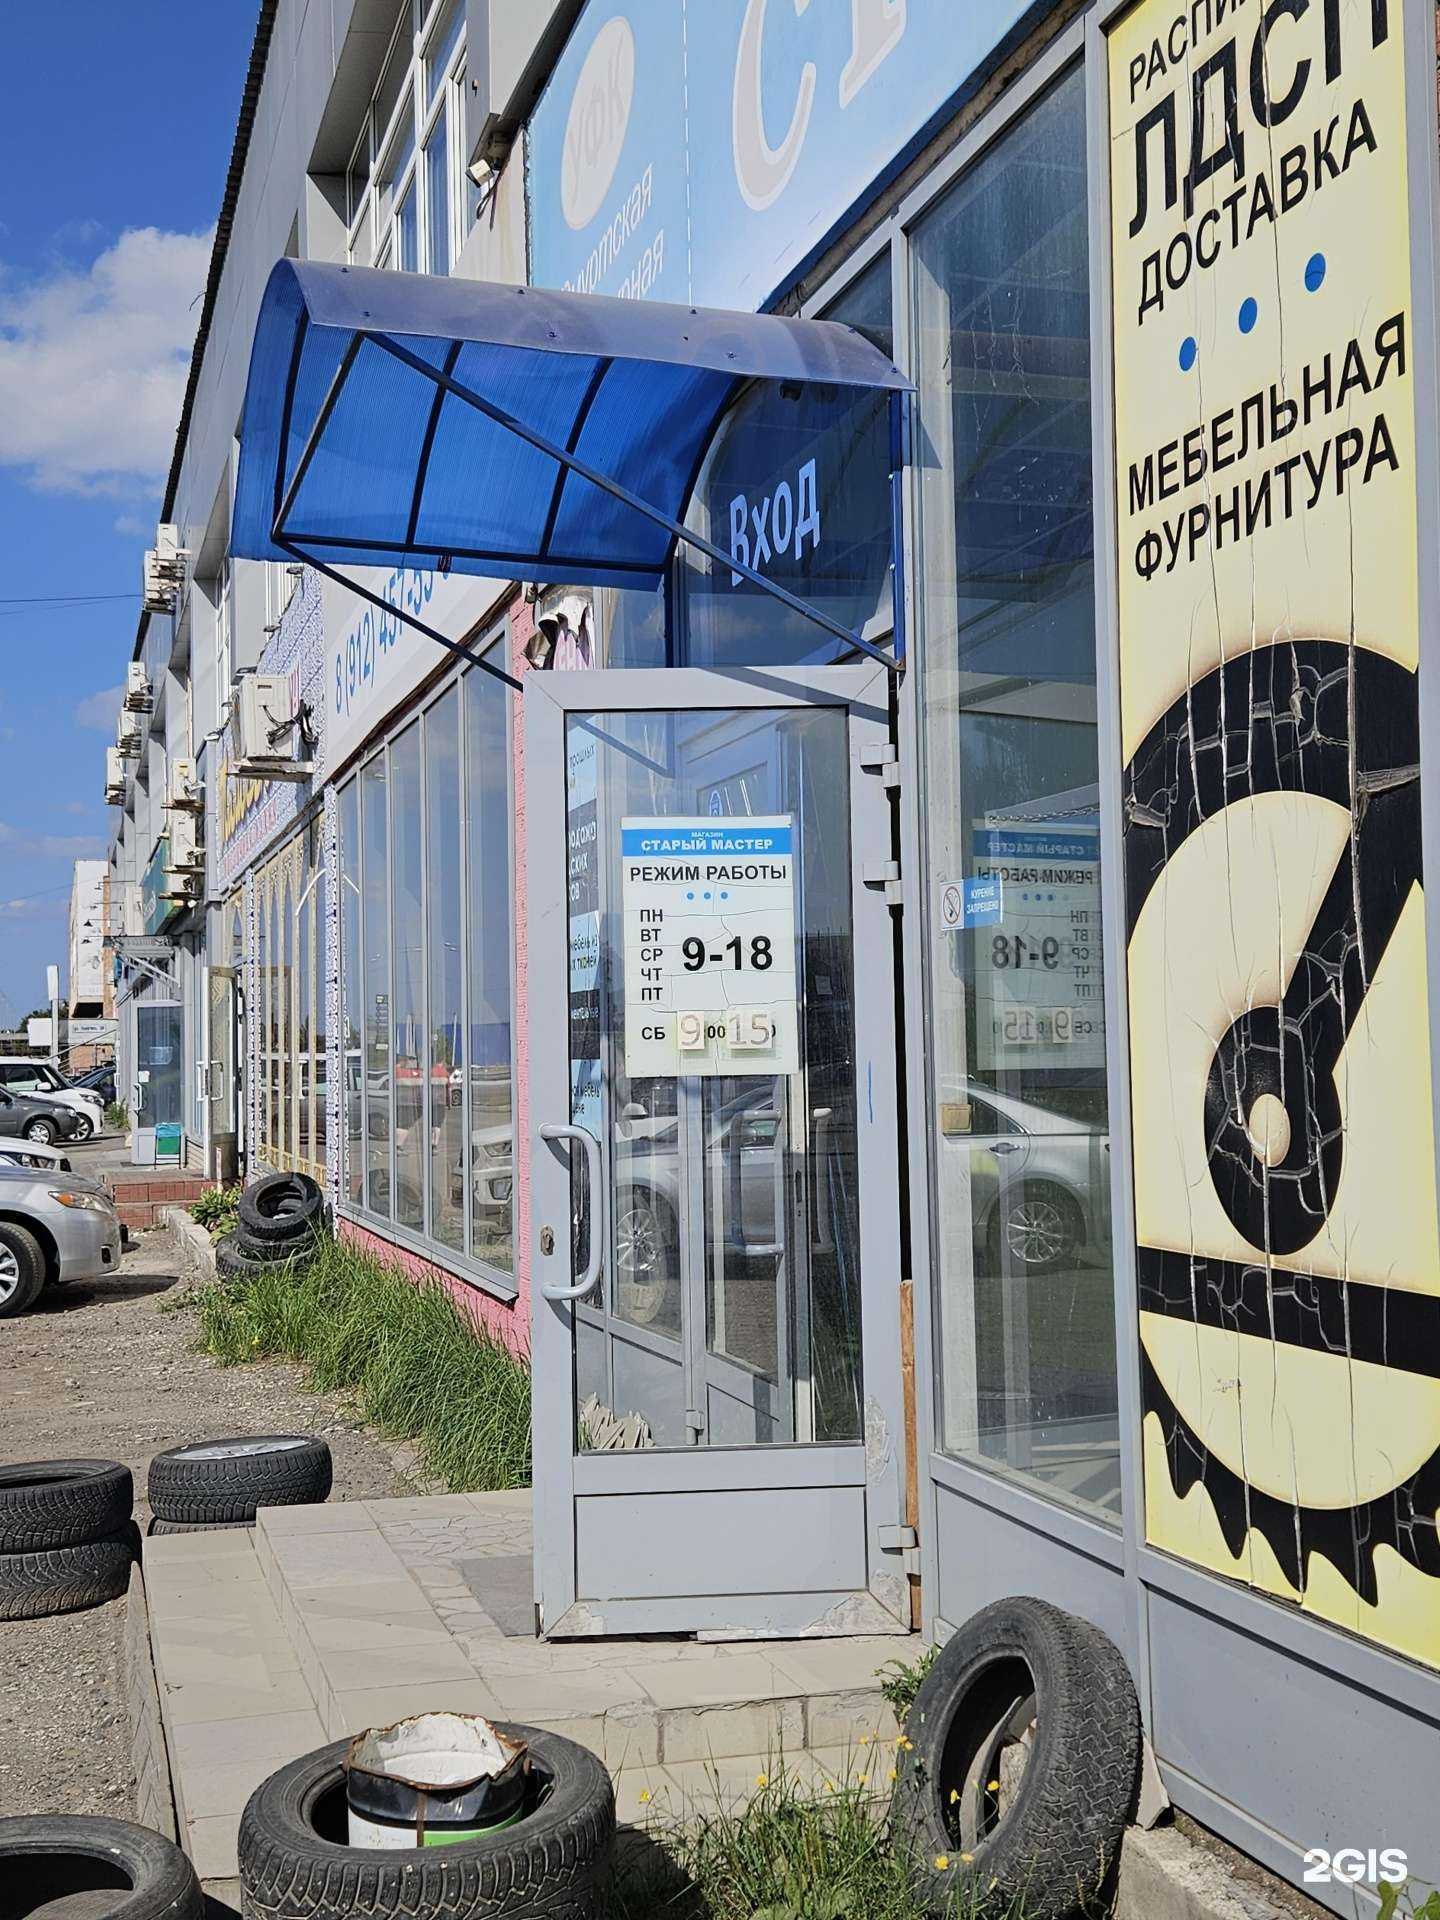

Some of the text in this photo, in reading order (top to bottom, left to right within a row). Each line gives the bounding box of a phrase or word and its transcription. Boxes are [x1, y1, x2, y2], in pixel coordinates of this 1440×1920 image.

[1129, 0, 1245, 104] РАСП
[1138, 98, 1378, 326] ДОСТАВКА
[1128, 311, 1406, 516] МЕБЕЛЬНАЯ
[1135, 412, 1400, 582] ФУРНИТУРА
[729, 457, 821, 587] Вход
[335, 653, 343, 715] 8
[345, 603, 376, 718] (912)
[691, 831, 723, 839] МАГАЗИН
[641, 838, 773, 851] СТАРЫЙ МАСТЕР
[630, 864, 786, 882] РЕЖИМ РАБОТЫ
[640, 908, 663, 922] ПН
[641, 928, 661, 942] ВТ
[641, 948, 663, 962] СР
[682, 935, 773, 971] 9-18
[641, 967, 663, 981] ЧТ
[641, 987, 663, 1000] ПТ
[641, 1026, 666, 1040] СБ
